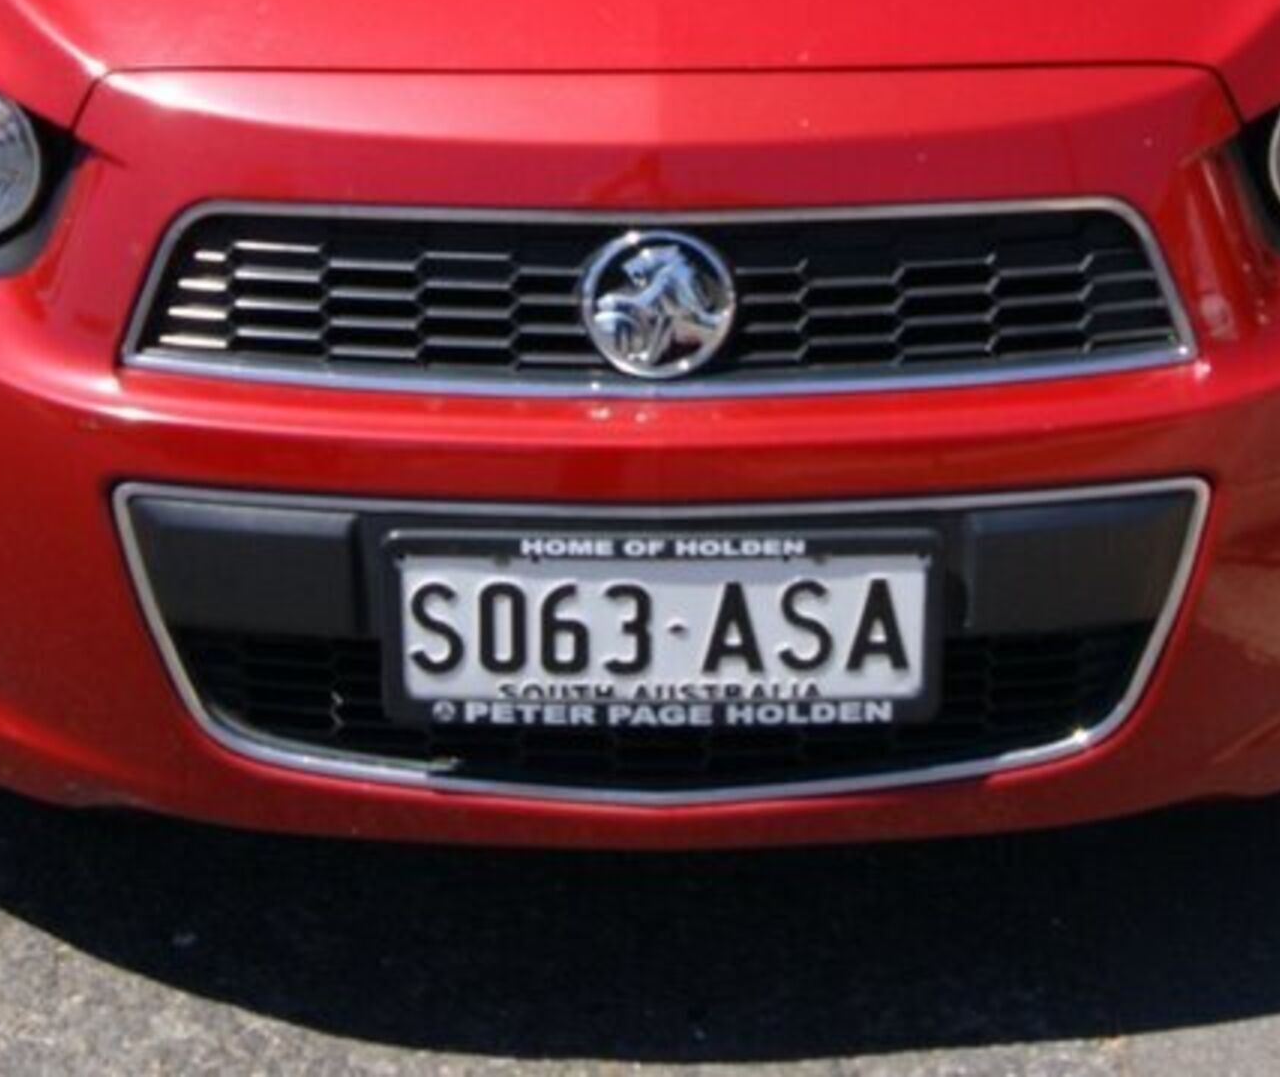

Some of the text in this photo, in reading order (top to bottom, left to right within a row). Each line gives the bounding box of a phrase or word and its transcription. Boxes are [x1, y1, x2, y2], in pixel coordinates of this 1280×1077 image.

[521, 538, 806, 556] HOME OF HOLDEN
[499, 683, 821, 700] SOUTH AUSTRALIA
[465, 701, 893, 725] PETER PAGE HOLDEN
